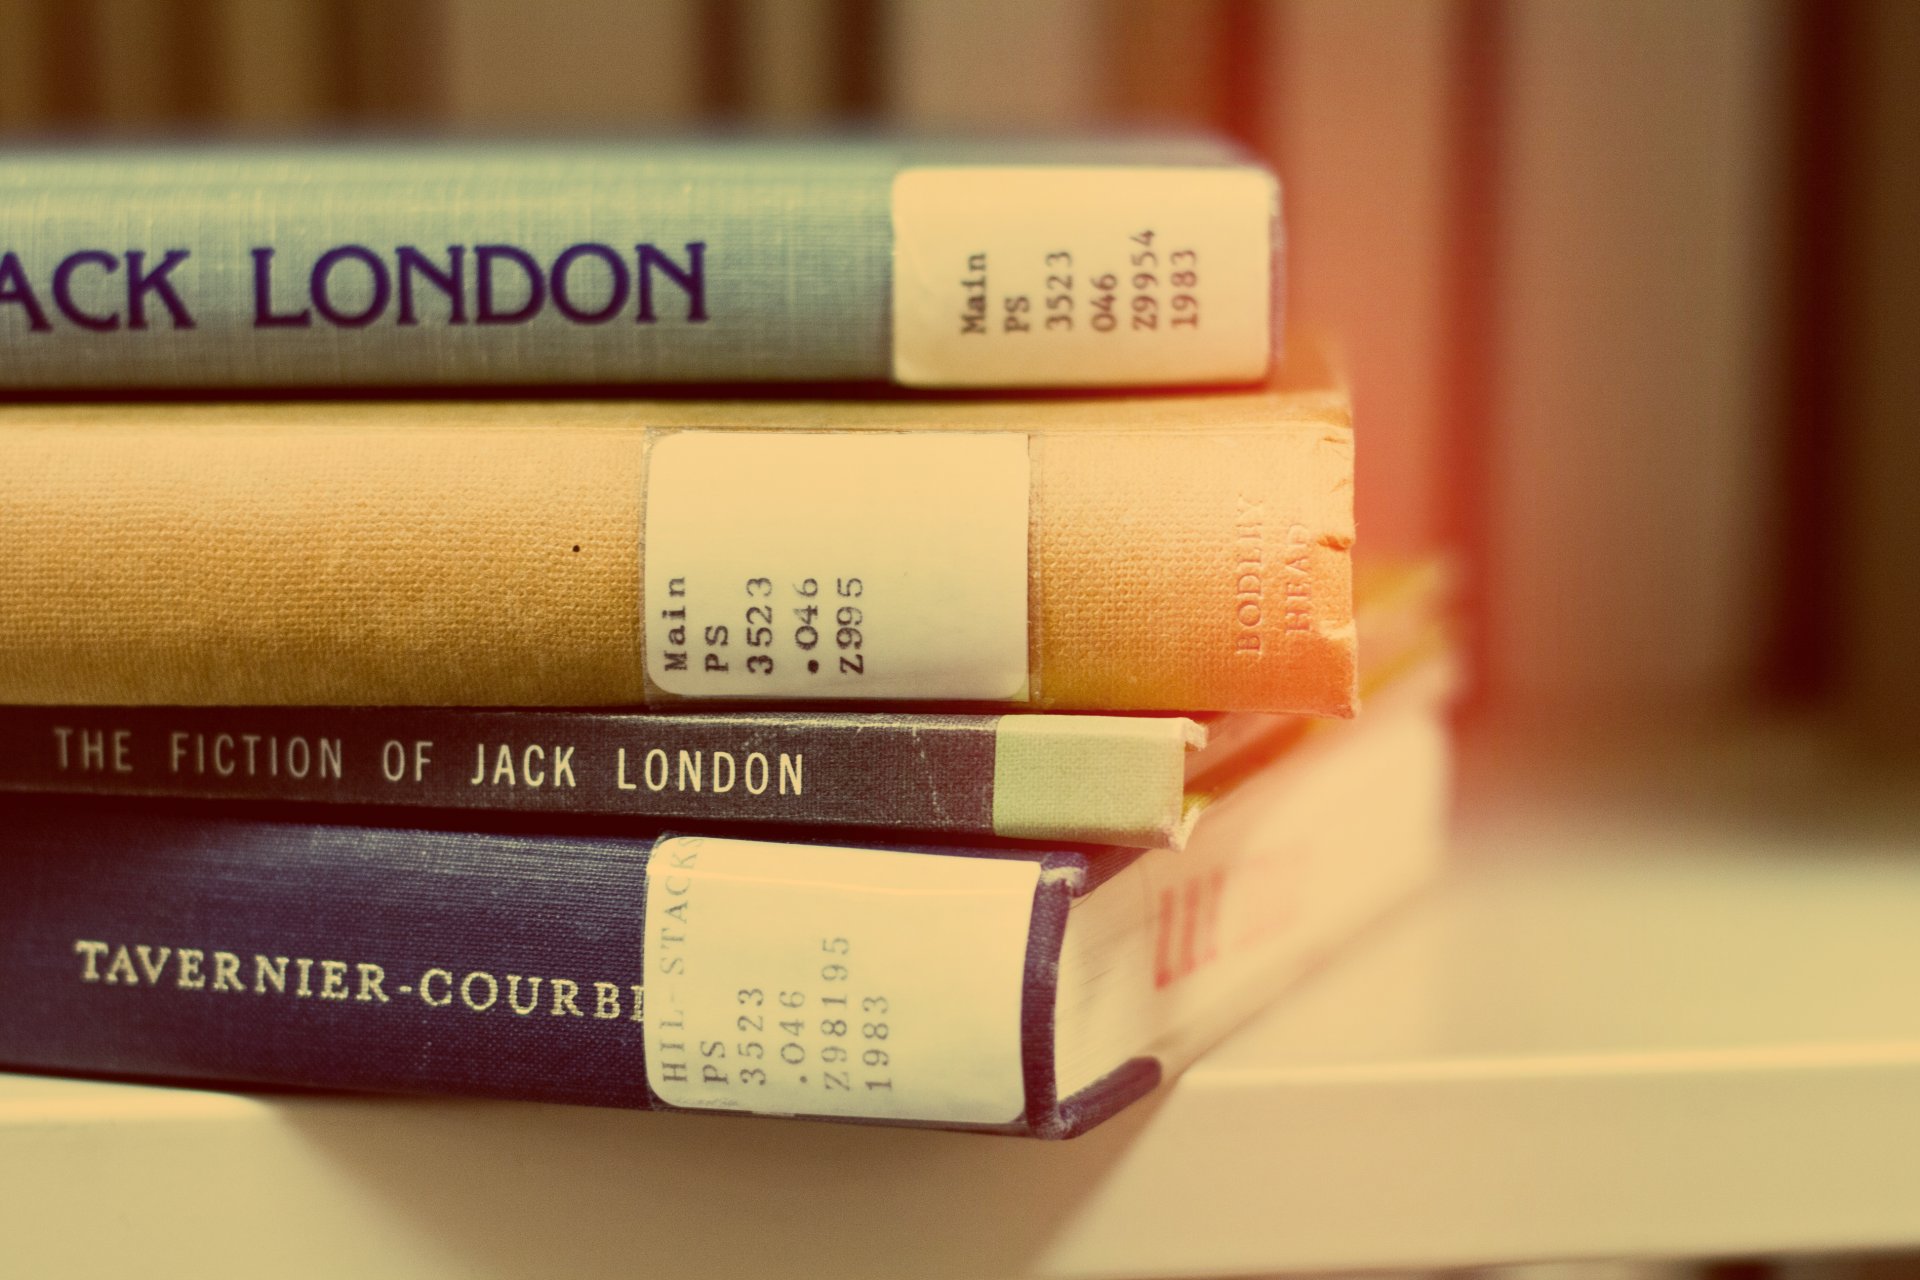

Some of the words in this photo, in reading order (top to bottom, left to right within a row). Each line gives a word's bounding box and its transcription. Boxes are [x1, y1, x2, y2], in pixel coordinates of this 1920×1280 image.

[251, 243, 709, 329] LONDON
[960, 253, 987, 335] Main
[1004, 295, 1031, 334] PS
[1044, 251, 1073, 332] 3523
[1130, 229, 1159, 332] Z9954
[1170, 249, 1198, 330] 1983
[1284, 523, 1311, 634] HEAD
[661, 577, 688, 672] Main
[704, 625, 730, 673] PS
[746, 577, 774, 675] 3523
[836, 577, 864, 675] Z995
[54, 727, 133, 773] THE
[169, 731, 343, 779] FICTION
[382, 740, 434, 782] OF
[471, 744, 576, 787] JACK
[618, 748, 803, 796] LONDON
[736, 988, 766, 1086] 3523
[820, 937, 850, 1091] Z98195
[862, 996, 892, 1091] 1983
[700, 1040, 729, 1085] PS
